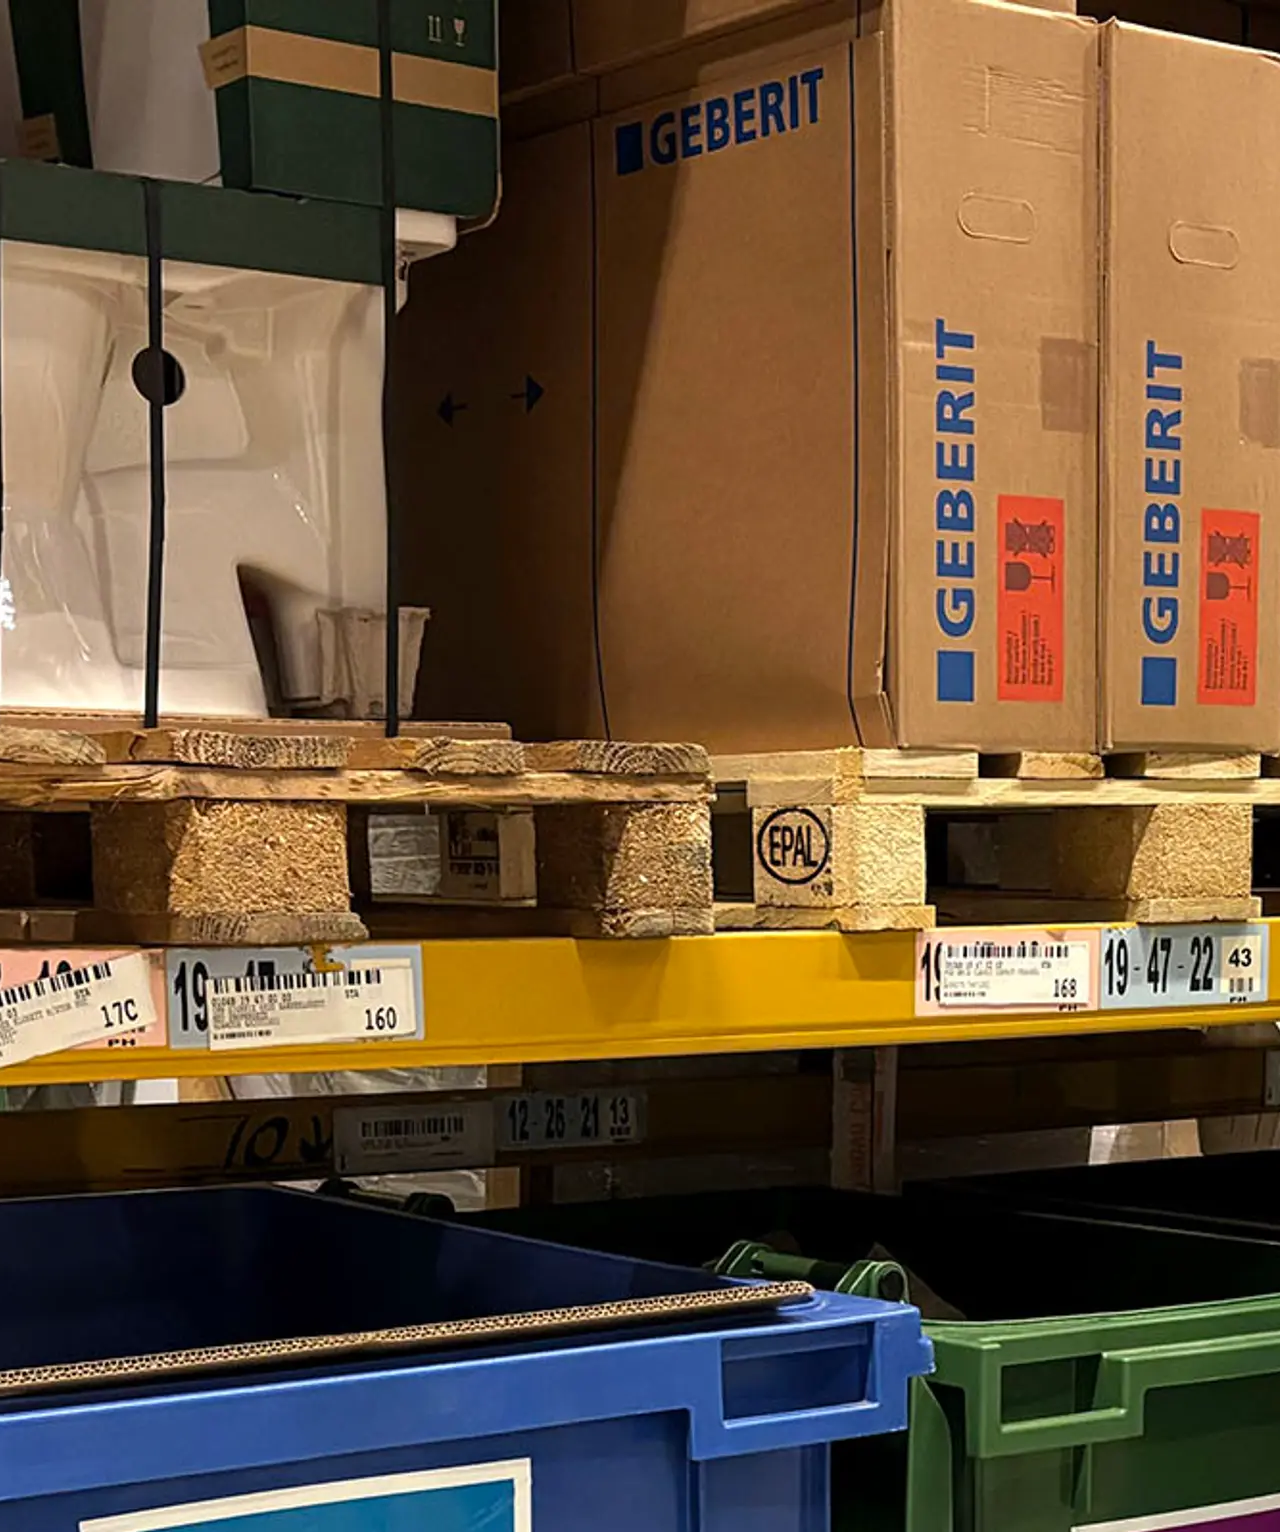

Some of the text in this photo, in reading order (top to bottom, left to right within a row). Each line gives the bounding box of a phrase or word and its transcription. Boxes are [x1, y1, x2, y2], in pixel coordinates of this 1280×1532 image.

[650, 68, 824, 166] GEBERIT
[935, 318, 976, 638] GEBERIT
[1143, 340, 1183, 645] GEBERIT
[769, 825, 818, 867] EPAL
[1228, 948, 1252, 967] 43
[101, 998, 139, 1029] 17C
[365, 1007, 397, 1030] 160
